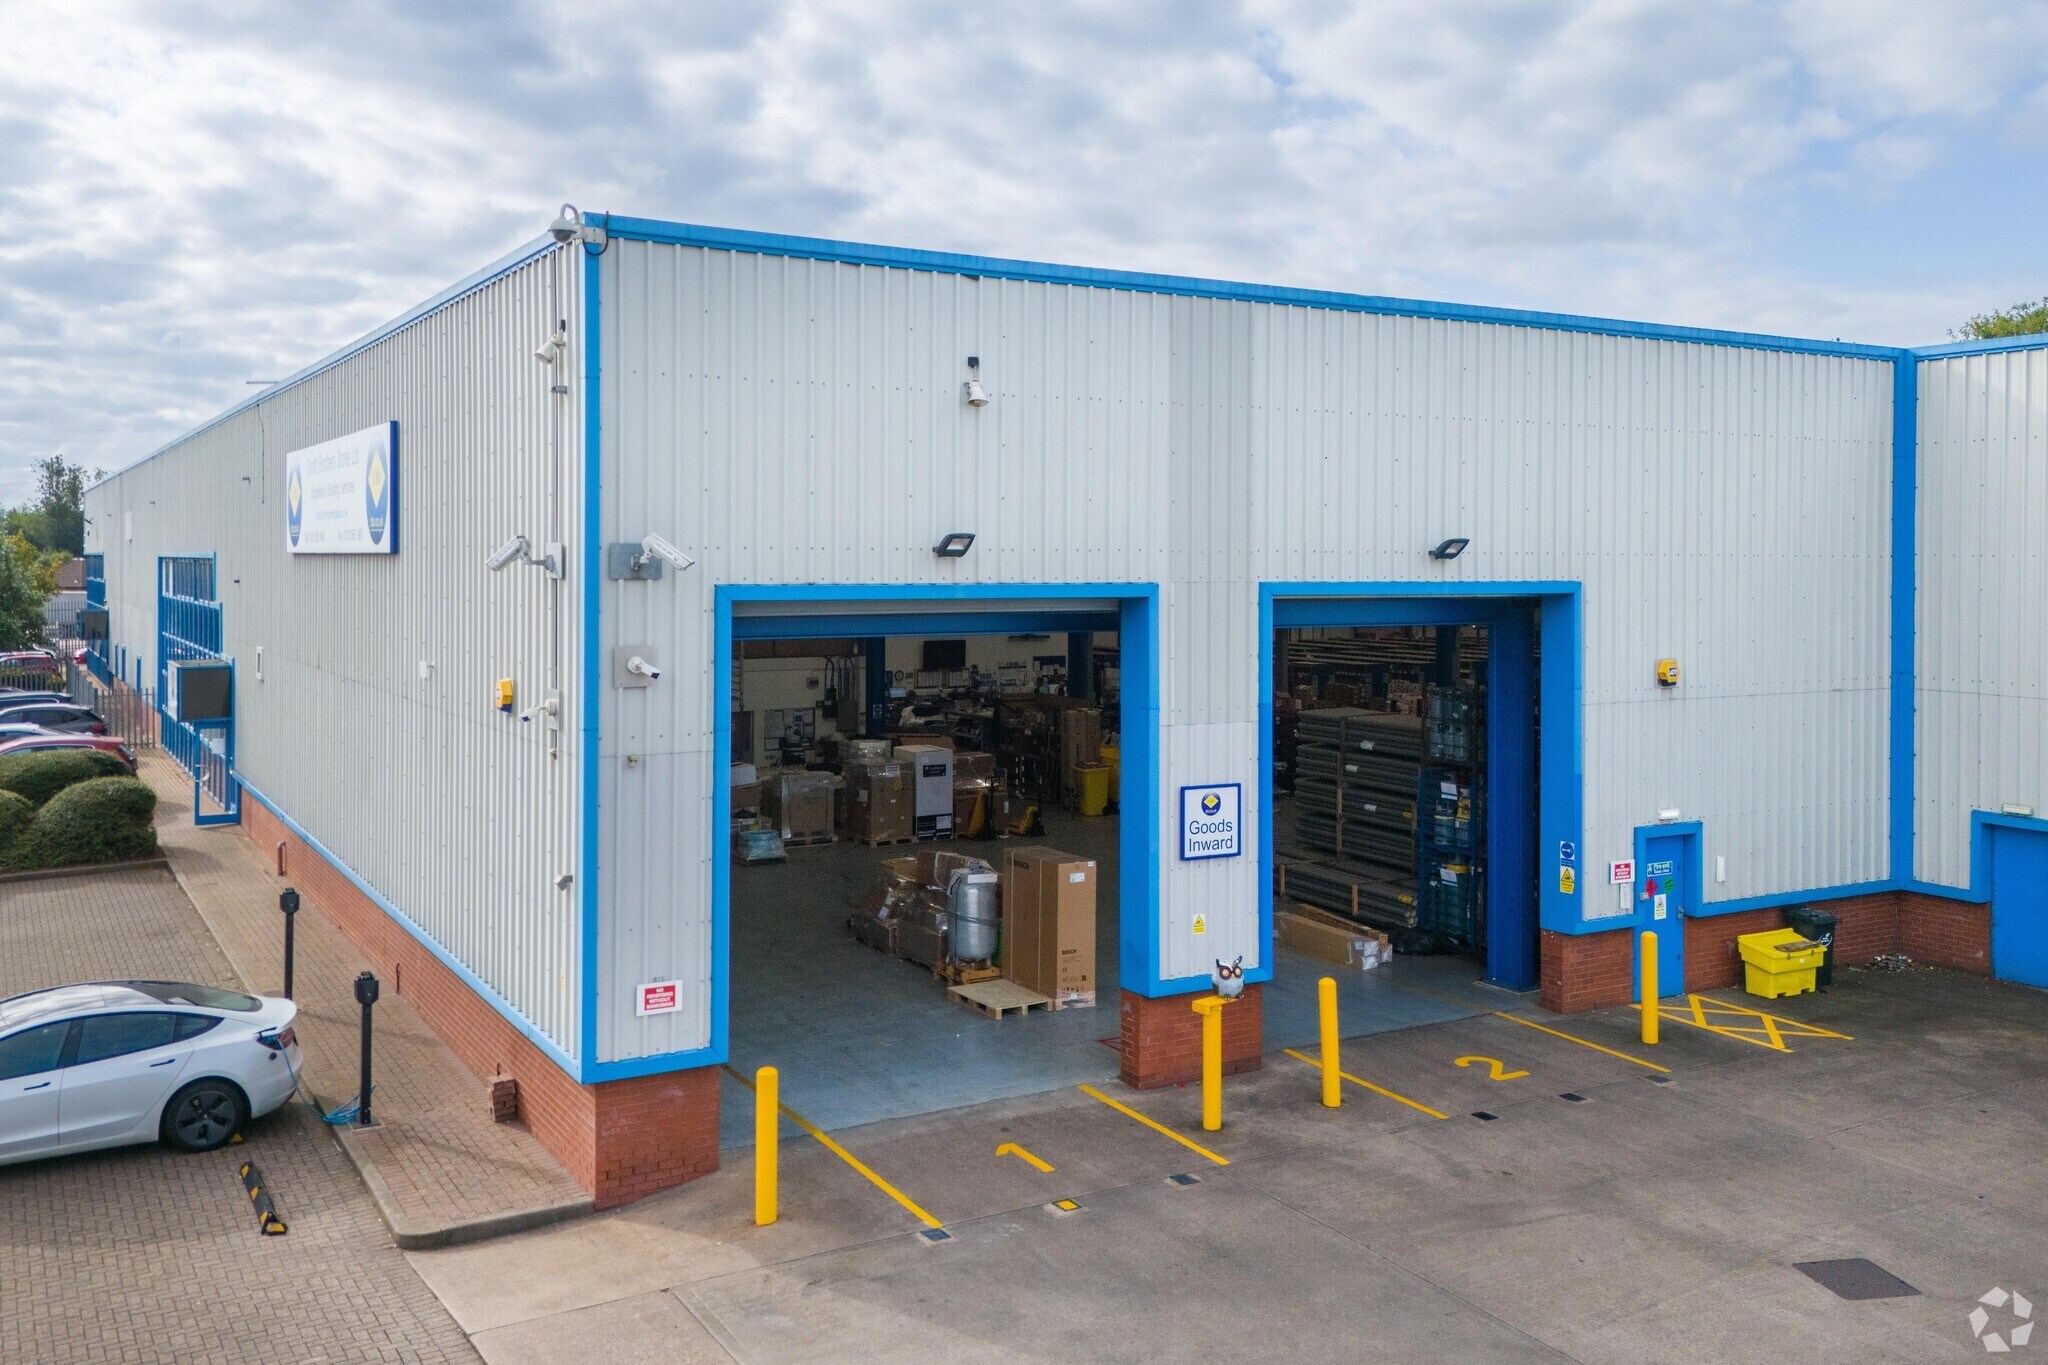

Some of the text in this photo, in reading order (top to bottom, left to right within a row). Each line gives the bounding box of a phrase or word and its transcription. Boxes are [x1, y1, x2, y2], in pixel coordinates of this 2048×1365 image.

[1189, 819, 1233, 835] Goods
[1189, 835, 1233, 852] Inward
[1454, 1055, 1531, 1081] 2
[995, 1142, 1056, 1172] 1
